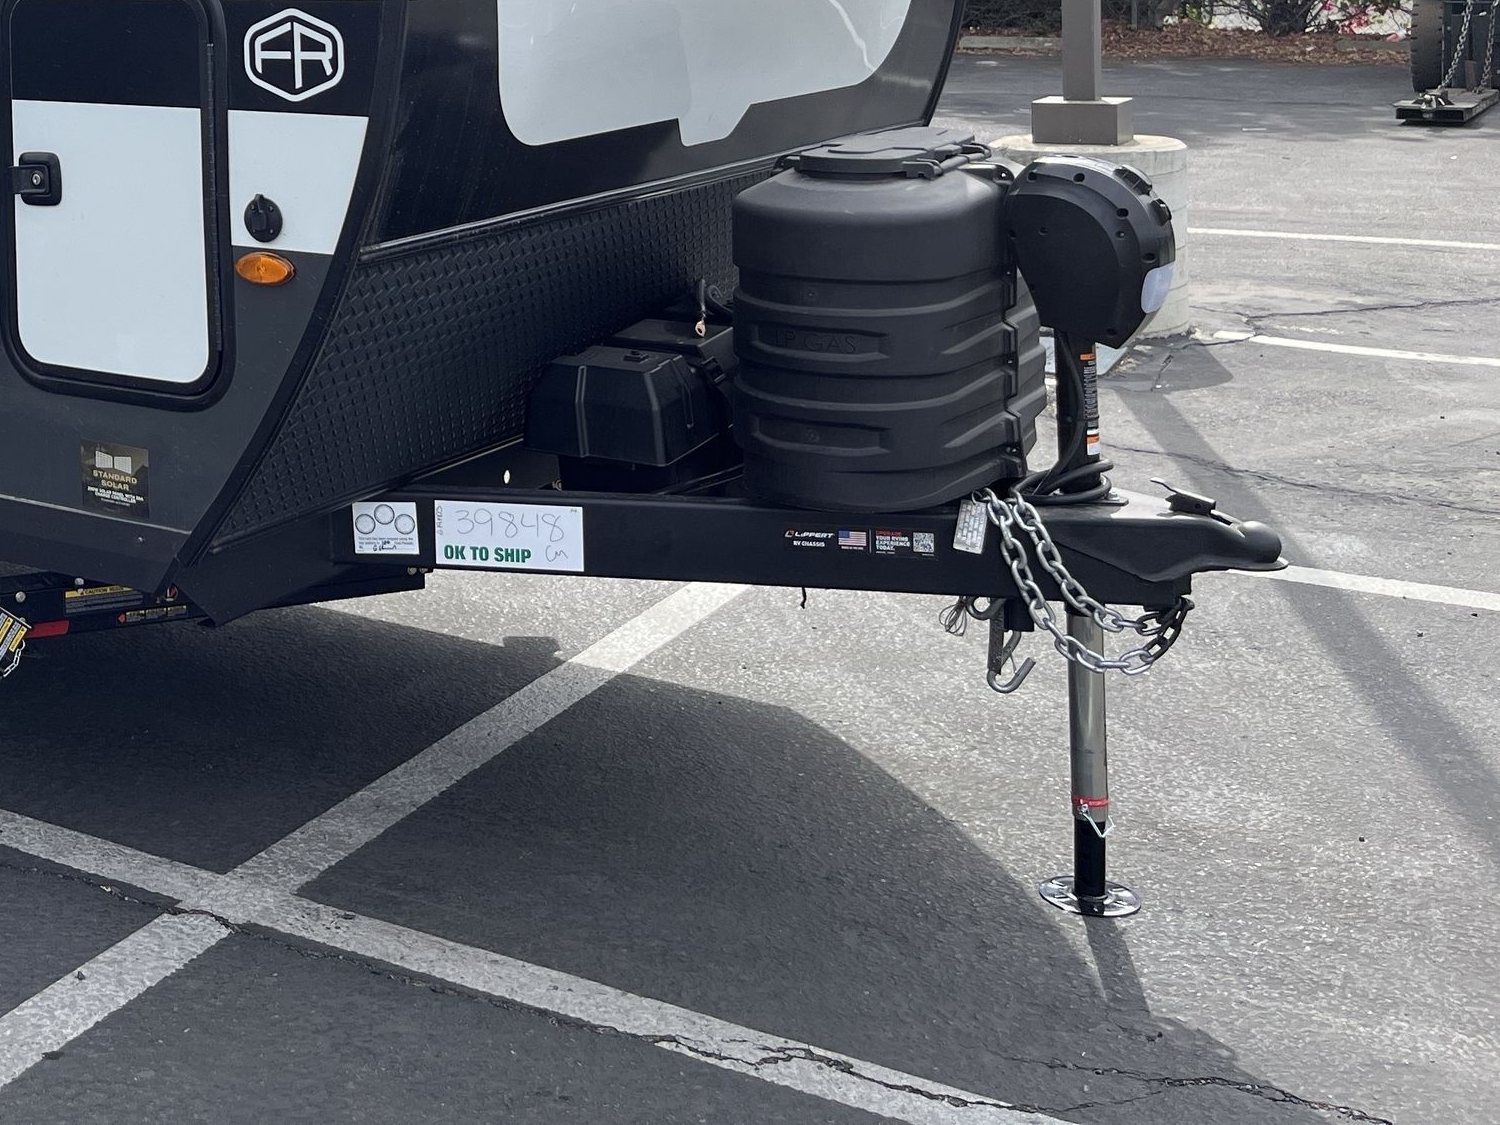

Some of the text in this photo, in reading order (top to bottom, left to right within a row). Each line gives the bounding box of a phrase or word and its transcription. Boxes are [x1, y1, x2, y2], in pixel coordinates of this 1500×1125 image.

[804, 334, 856, 354] GAS
[93, 470, 137, 484] STANDARD
[101, 480, 129, 491] SOLAR
[454, 508, 565, 542] 39848
[801, 540, 826, 548] CHASSIS
[444, 544, 532, 563] OK TO SHIP
